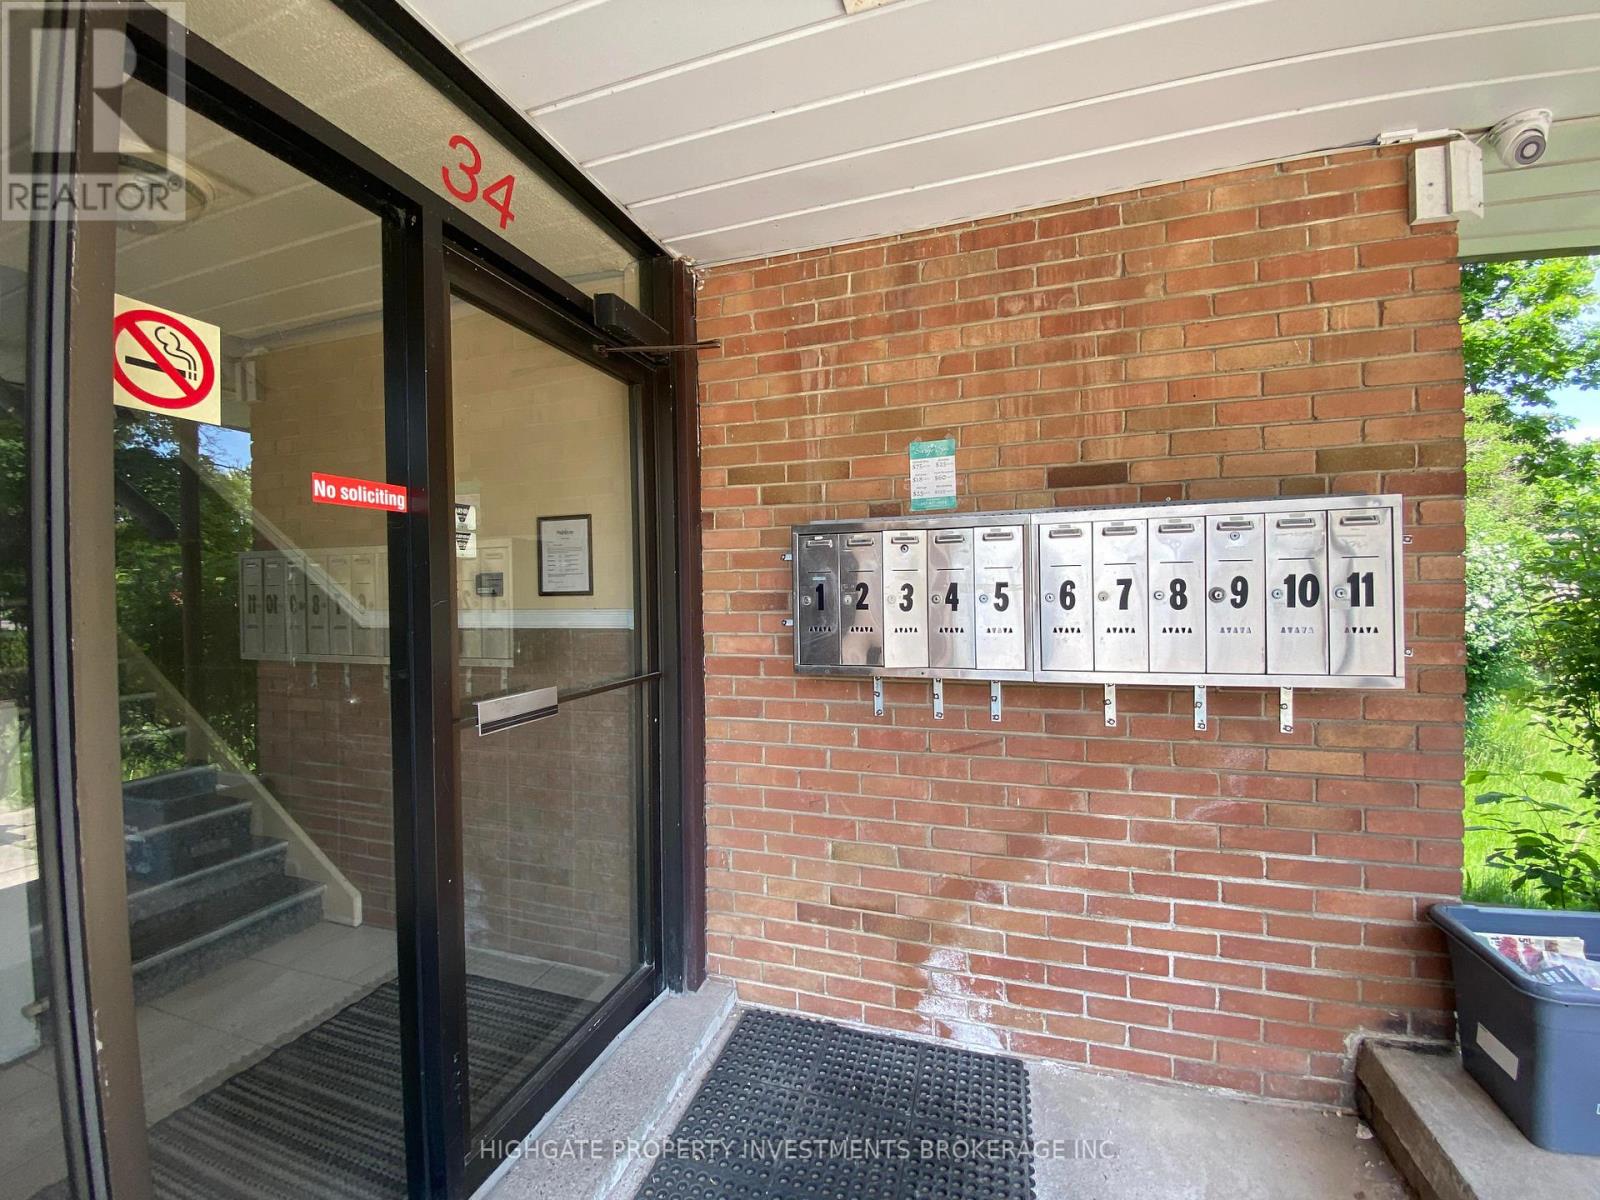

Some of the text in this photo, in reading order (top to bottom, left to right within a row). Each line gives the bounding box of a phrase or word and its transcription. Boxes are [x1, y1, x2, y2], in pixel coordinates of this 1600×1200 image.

[442, 135, 515, 229] 34
[314, 480, 405, 510] No soliciting
[815, 583, 825, 611] 1
[855, 582, 869, 611] 2
[899, 583, 914, 612] 3
[944, 582, 959, 611] 4
[993, 581, 1009, 612] 5
[1059, 579, 1076, 611] 6
[1116, 578, 1133, 610] 7
[1169, 578, 1188, 611] 8
[1230, 575, 1249, 609] 9
[1283, 573, 1320, 609] 10
[1346, 571, 1375, 607] 11
